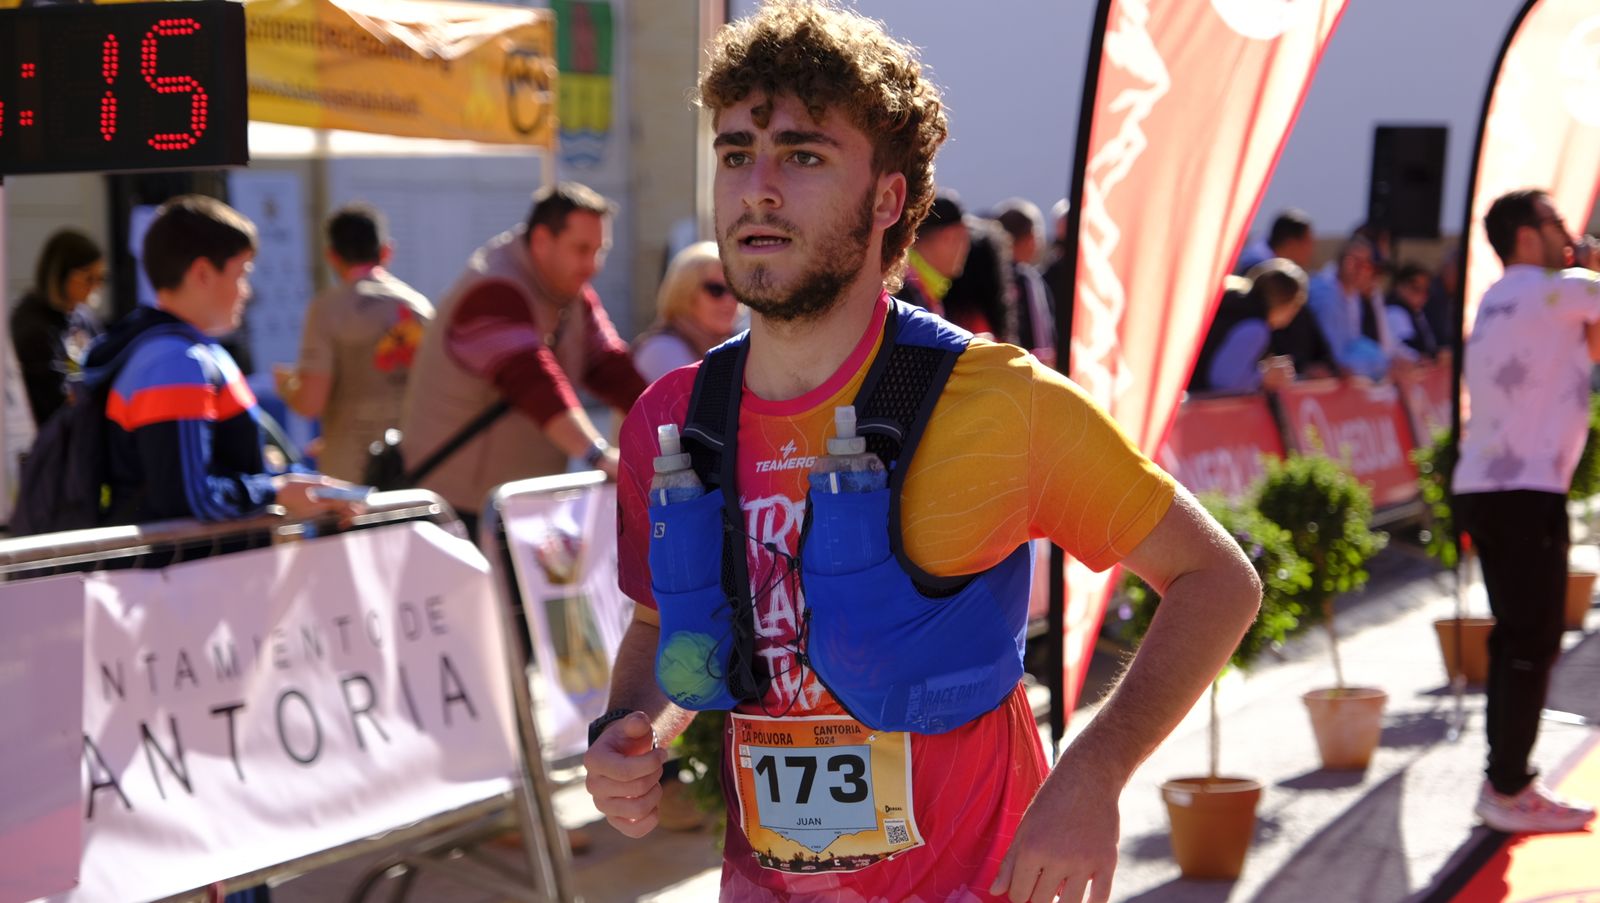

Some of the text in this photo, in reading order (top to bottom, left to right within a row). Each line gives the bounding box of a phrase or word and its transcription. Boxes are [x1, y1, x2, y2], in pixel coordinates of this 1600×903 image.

[0, 17, 208, 151] :15
[755, 456, 818, 472] TEAMERG
[402, 595, 448, 642] DE
[742, 730, 752, 743] LA
[813, 725, 862, 736] CANTORIA
[814, 736, 836, 746] 2024
[755, 754, 869, 804] 173
[796, 817, 822, 826] JUAN
